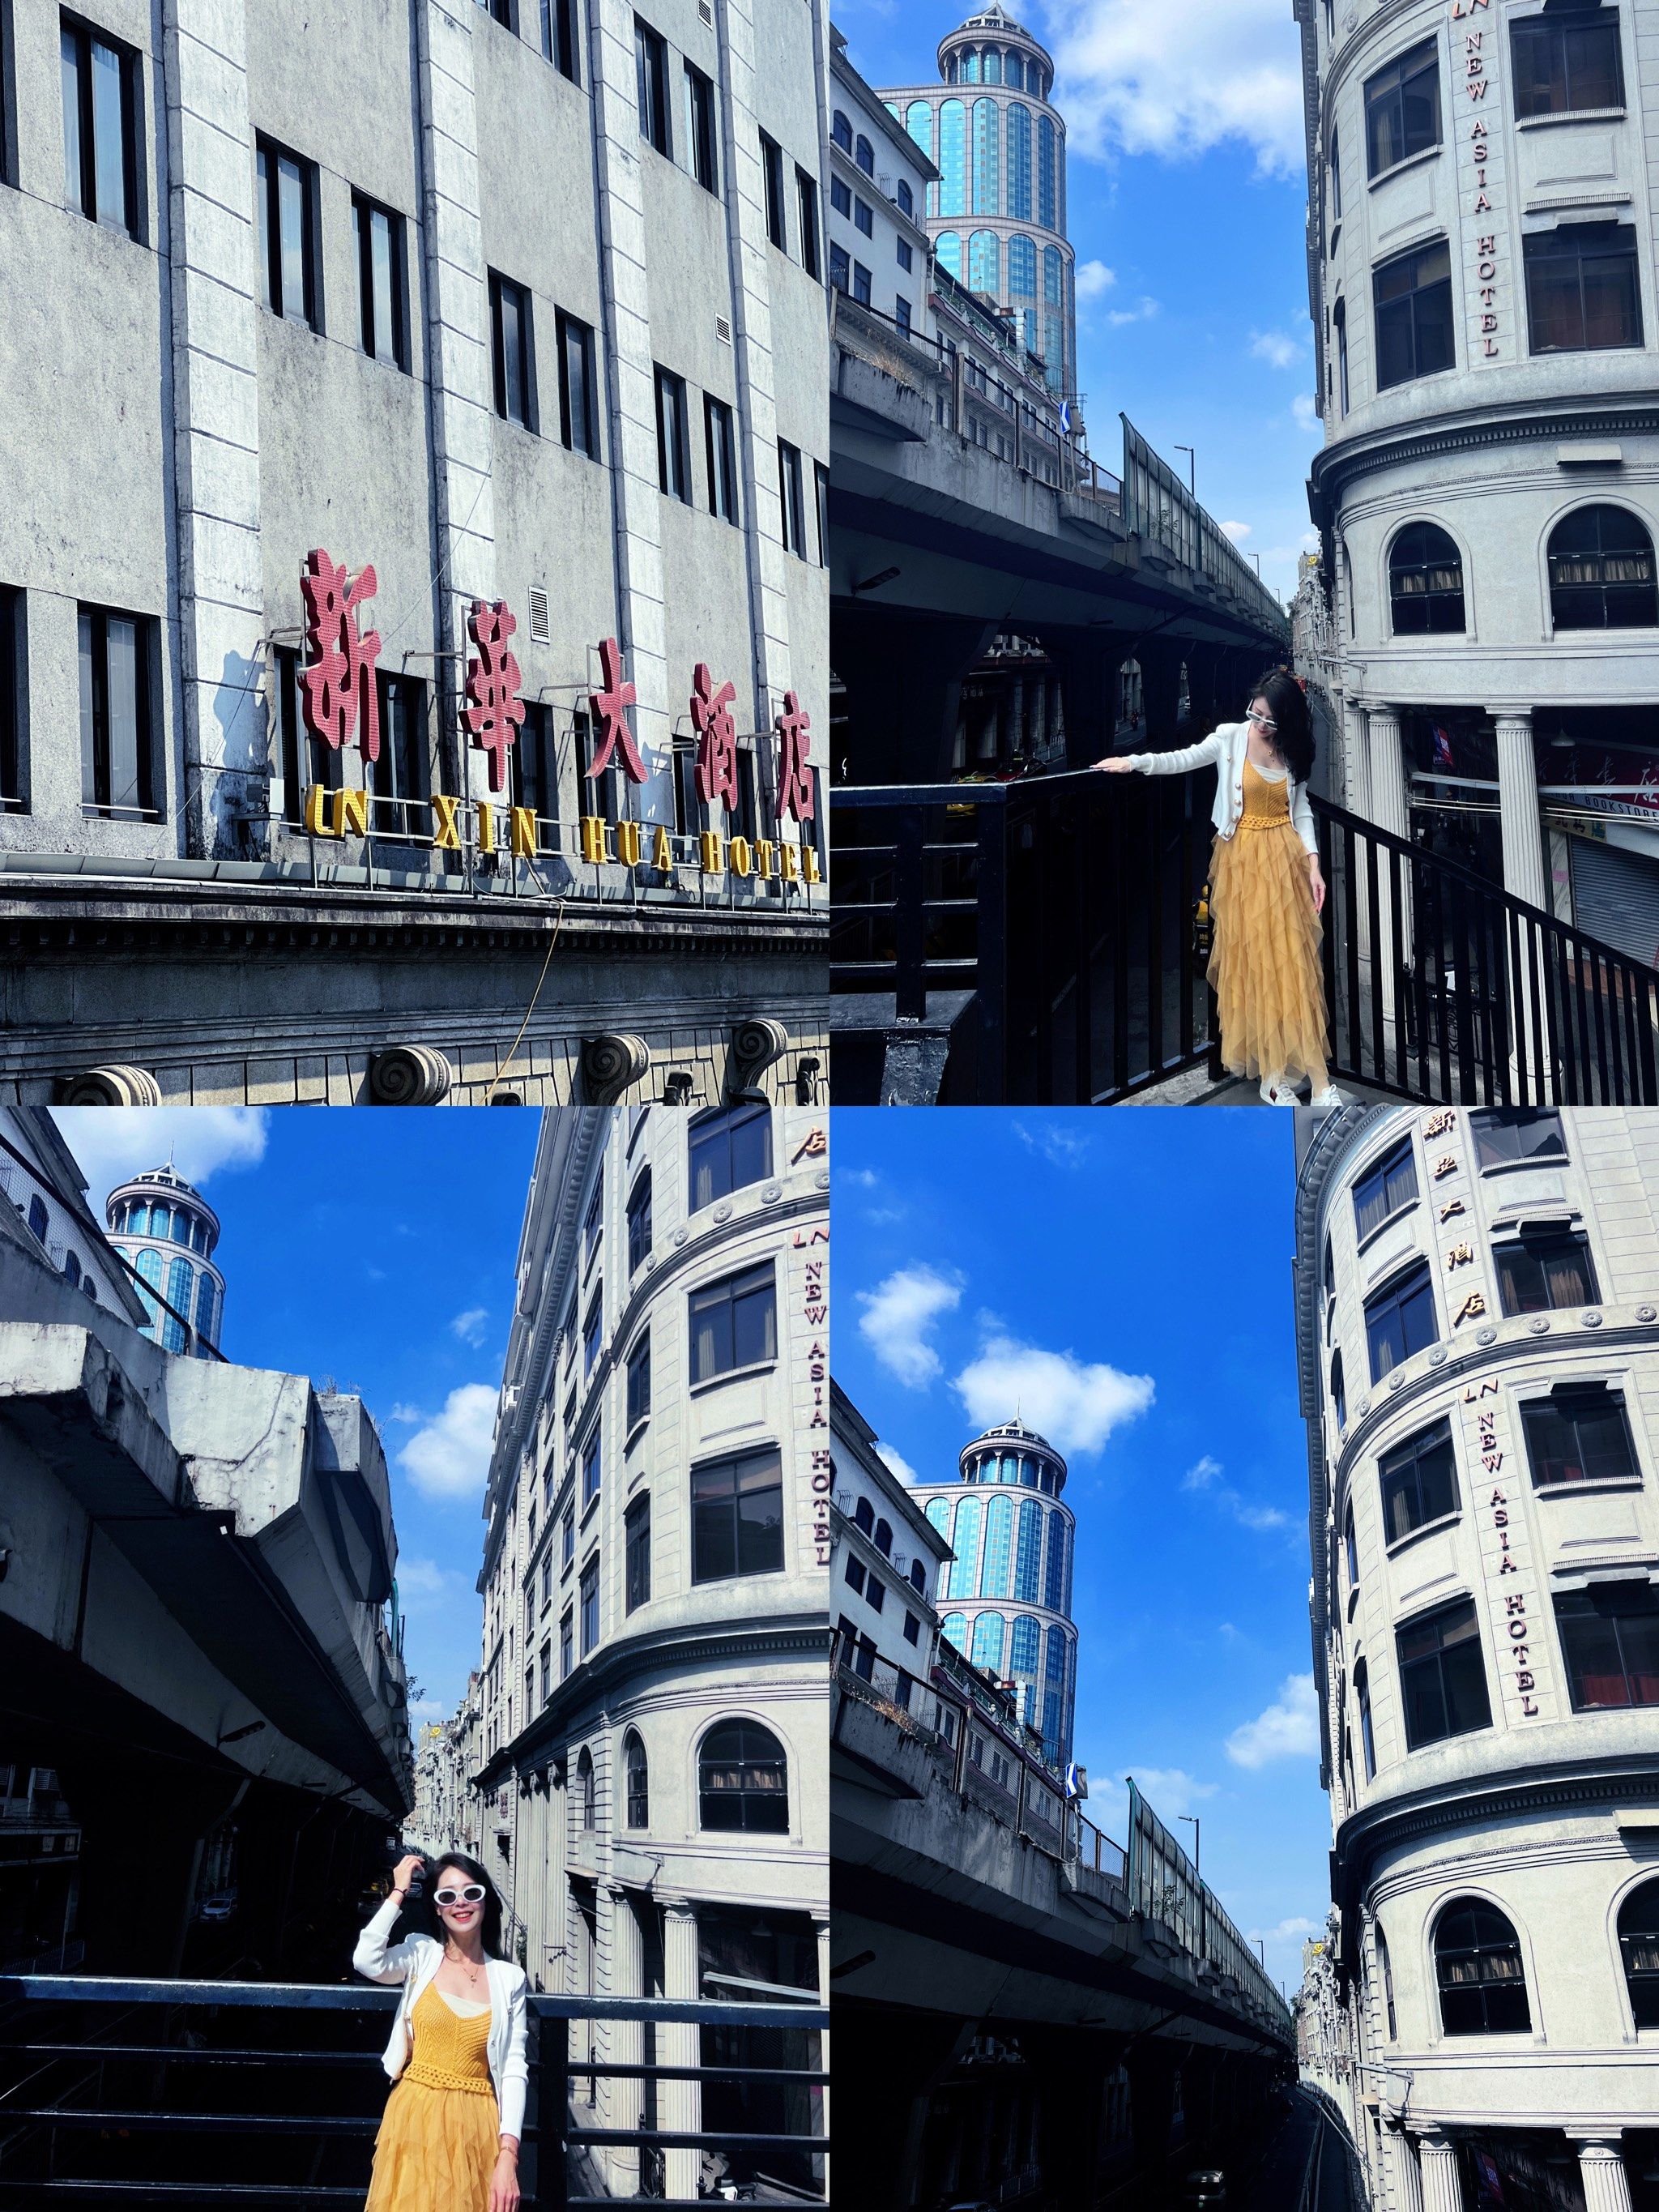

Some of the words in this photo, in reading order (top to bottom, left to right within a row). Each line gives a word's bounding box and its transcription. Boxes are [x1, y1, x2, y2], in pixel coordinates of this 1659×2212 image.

[1465, 32, 1489, 103] NEW
[1471, 119, 1491, 213] ASIA
[1477, 234, 1498, 357] HOTEL
[430, 794, 538, 858] XIN
[579, 815, 674, 872] HUA
[700, 831, 821, 884] HOTEL
[804, 1262, 827, 1326] NEW
[808, 1340, 827, 1428] ASIA
[812, 1450, 830, 1566] HOTEL
[1477, 1411, 1503, 1473] NEW
[1490, 1486, 1516, 1574] ASIA
[1504, 1594, 1538, 1717] HOTEL
